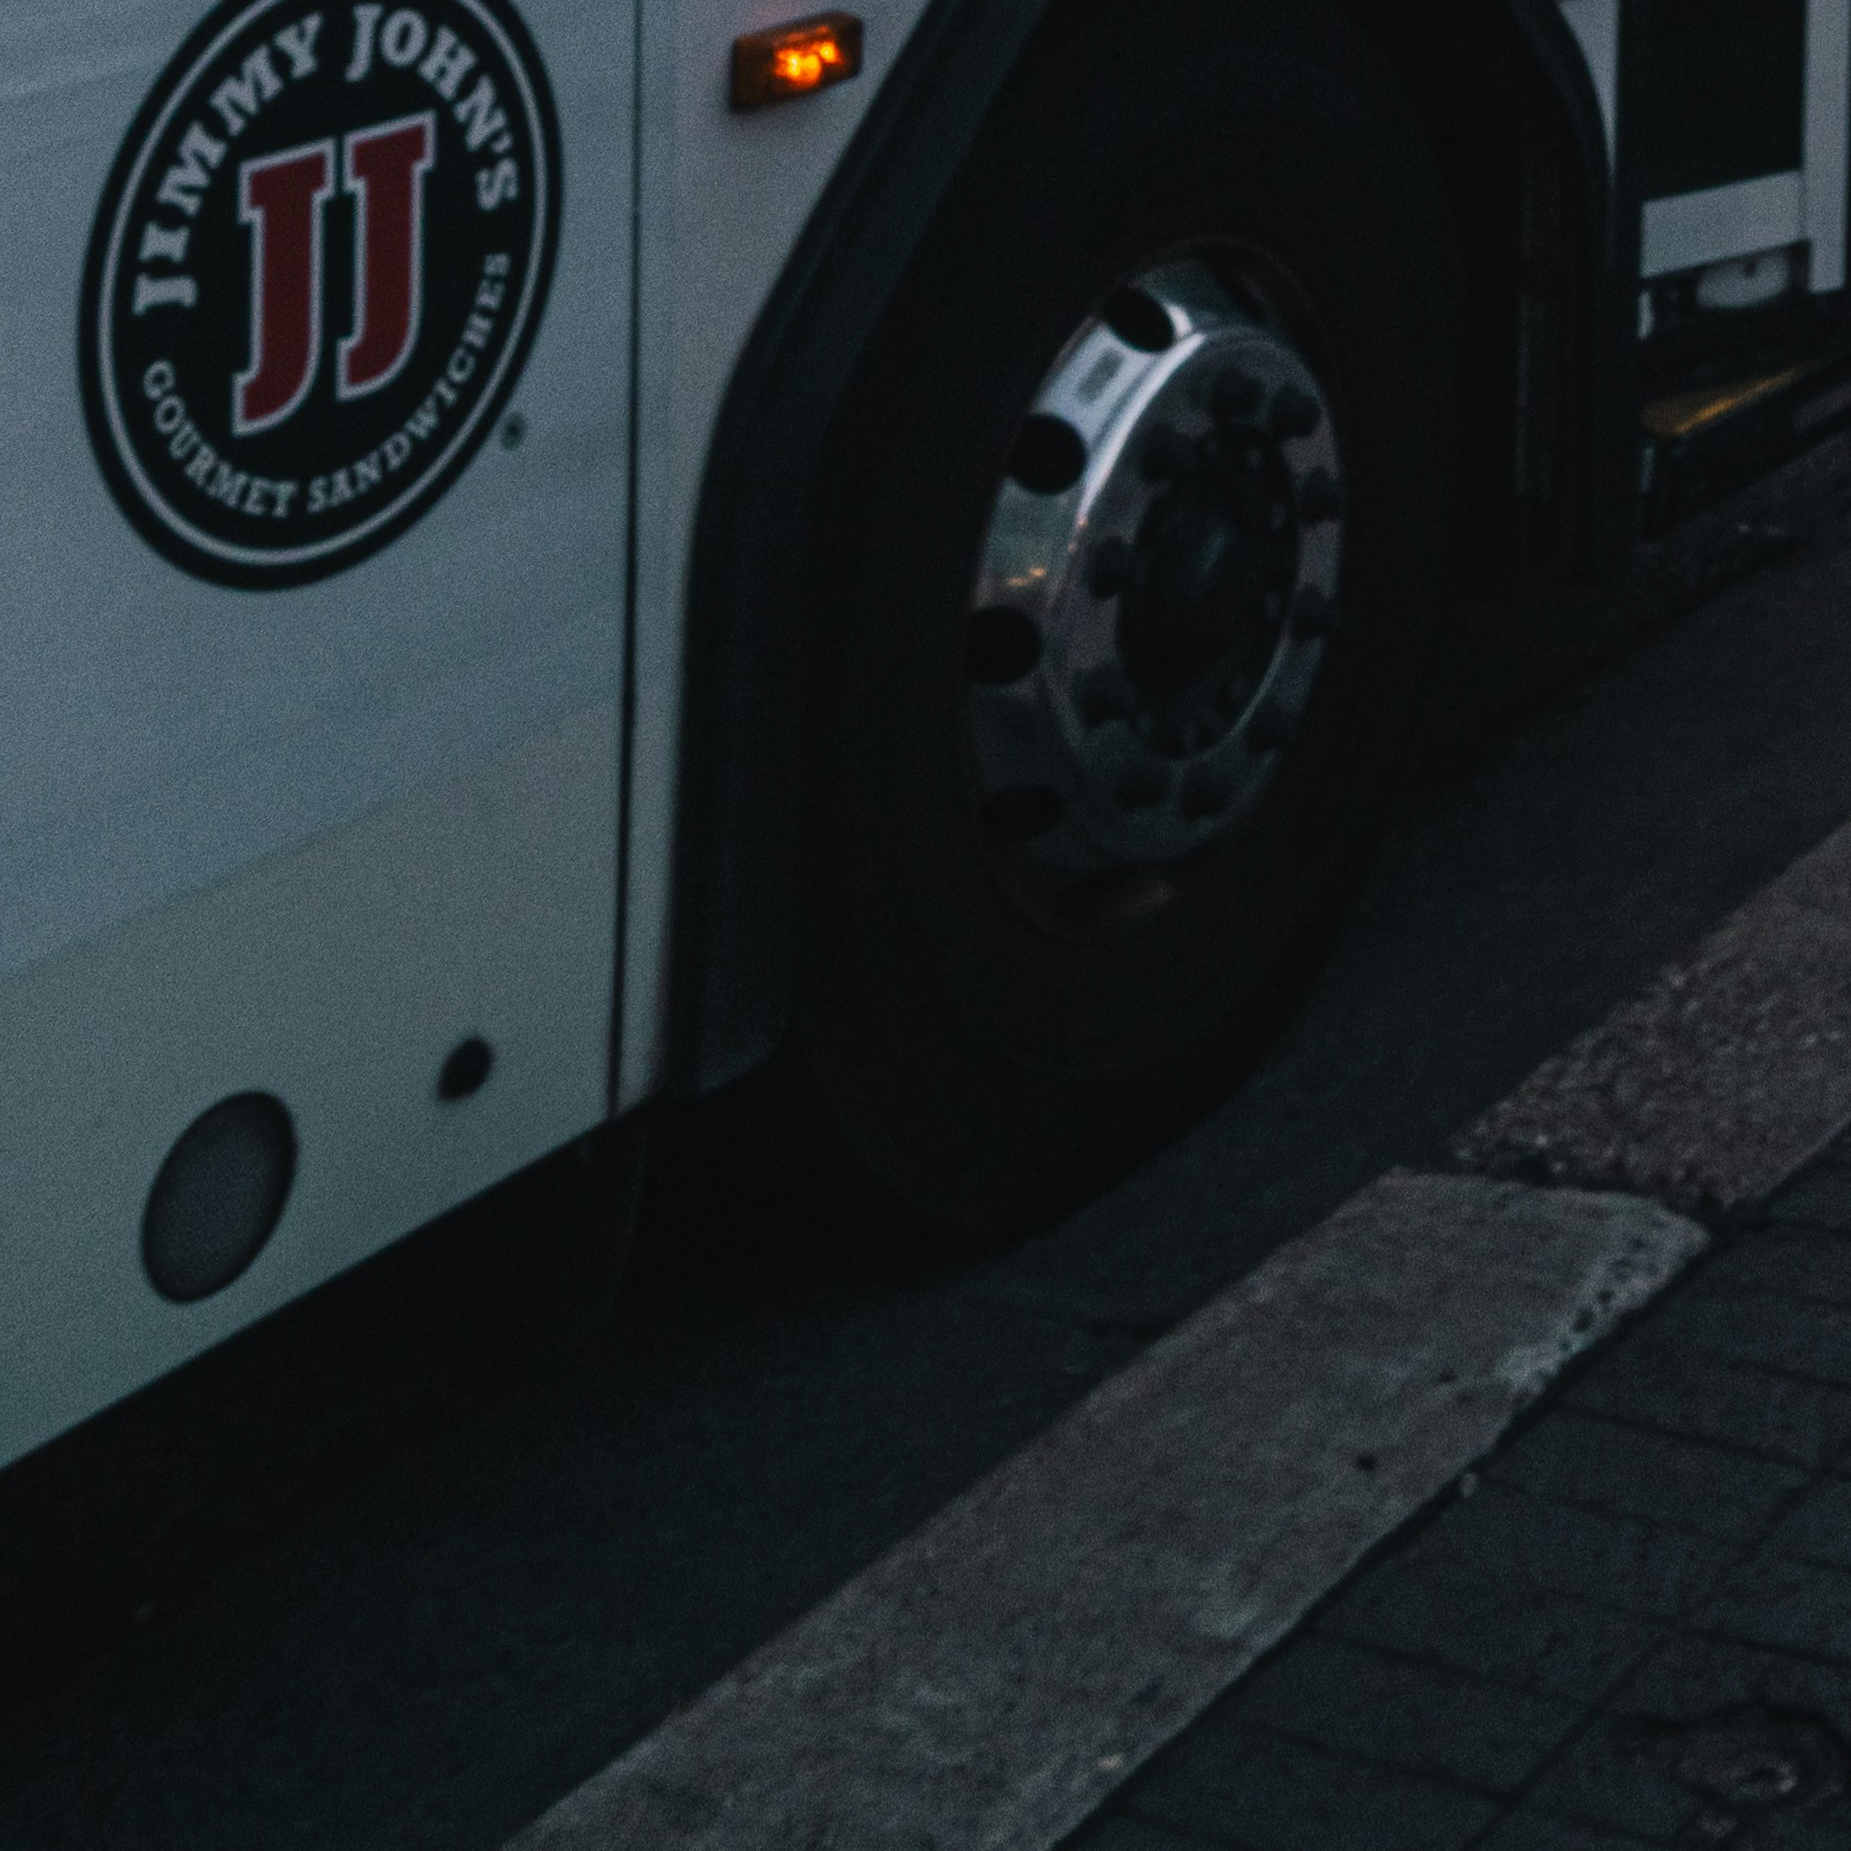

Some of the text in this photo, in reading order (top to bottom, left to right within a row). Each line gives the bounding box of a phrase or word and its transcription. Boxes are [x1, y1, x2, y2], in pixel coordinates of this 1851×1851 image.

[132, 3, 519, 316] JIMMY JOHN'S
[232, 109, 437, 437] JJ
[143, 251, 511, 519] GOURMET SANDWICHES
